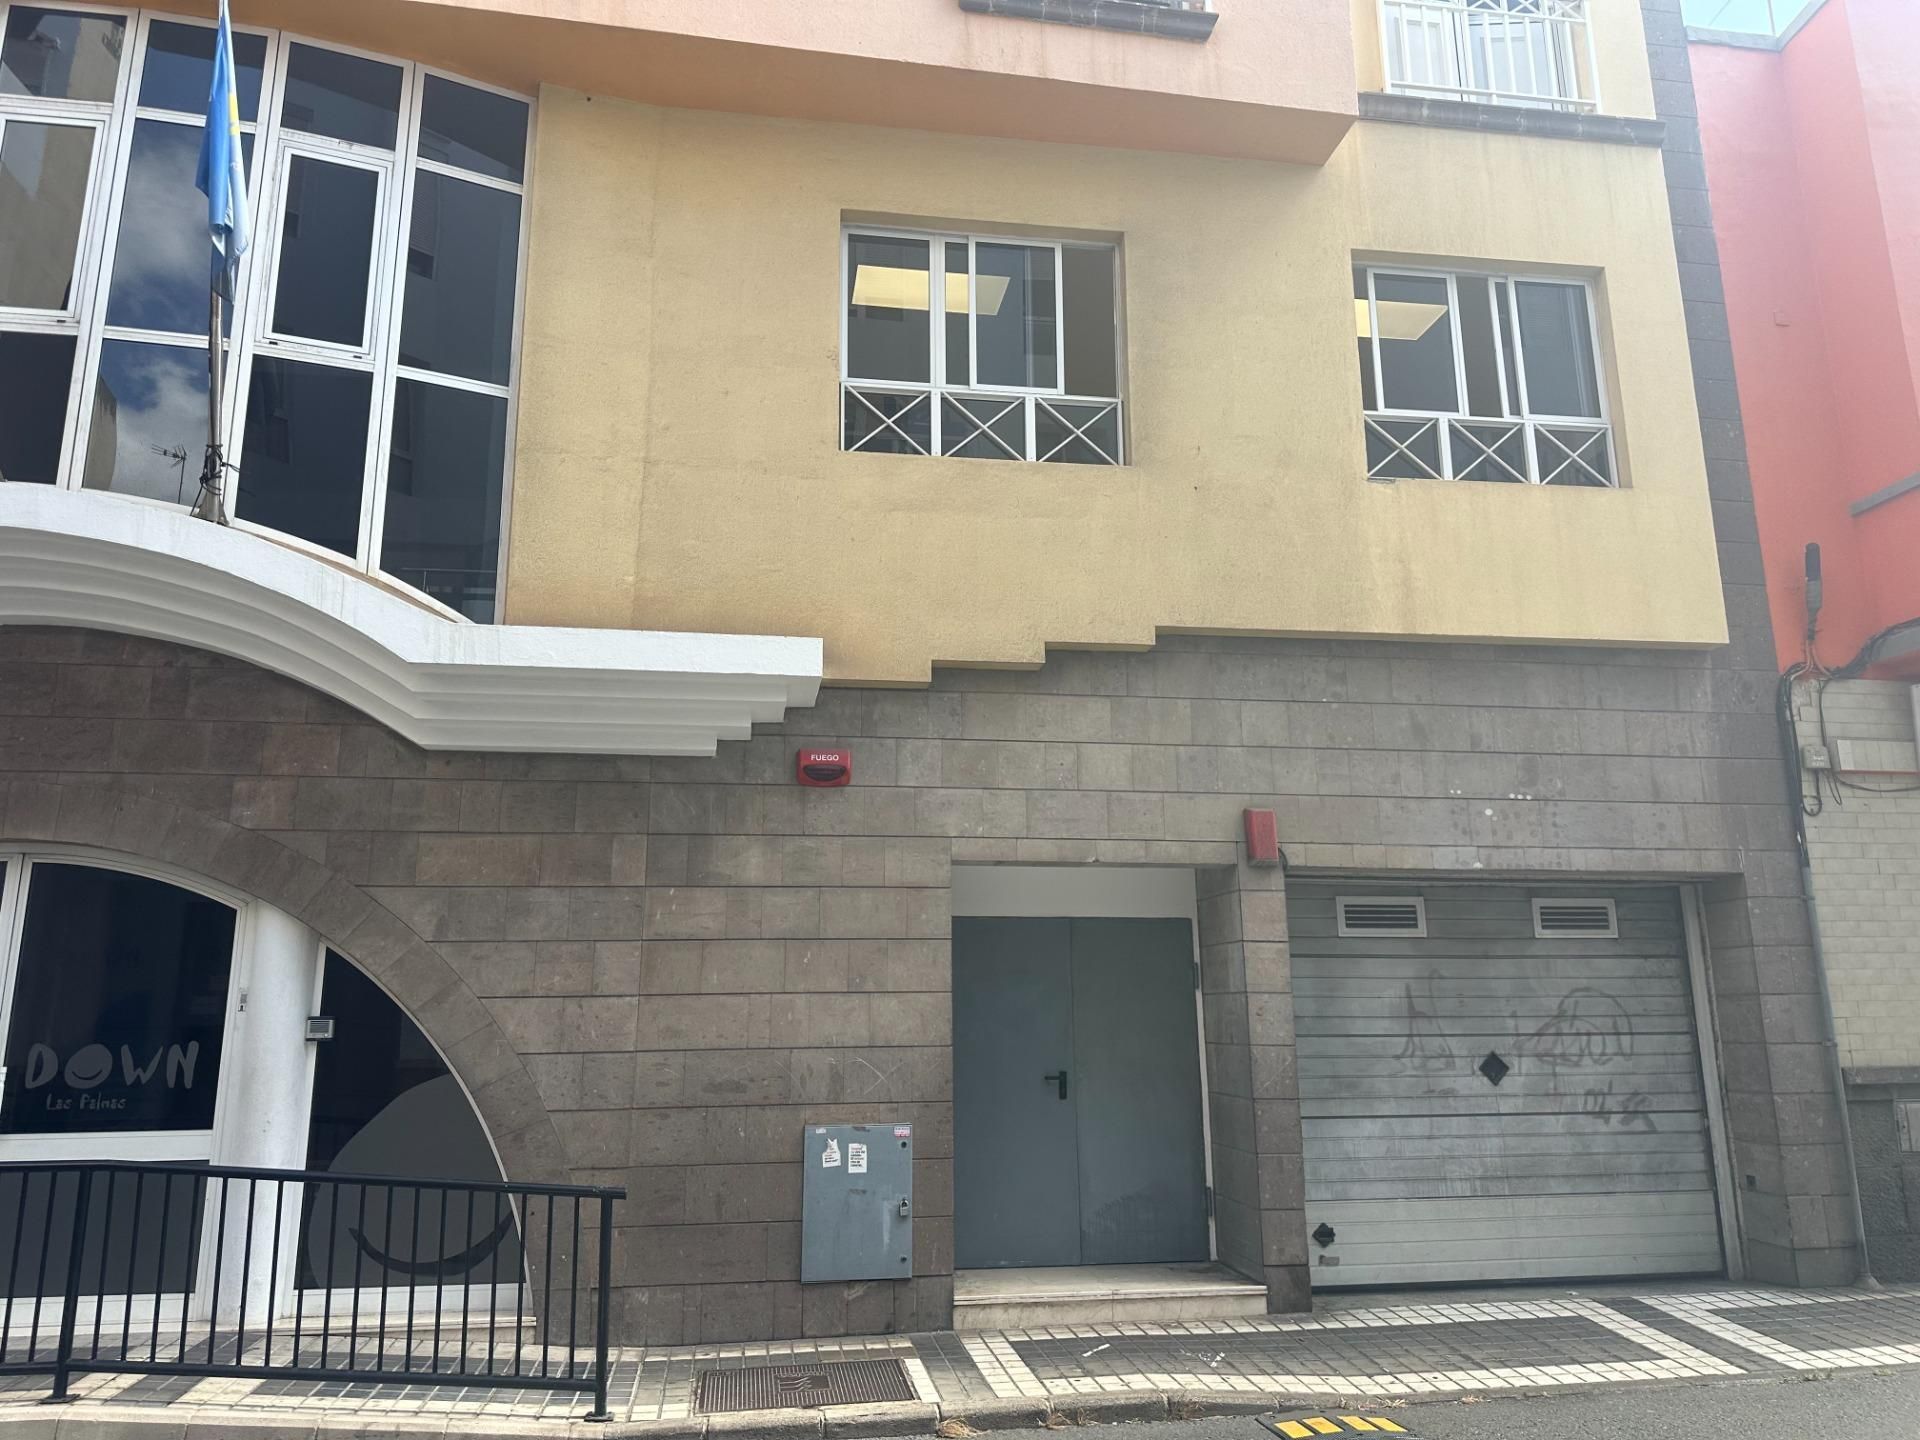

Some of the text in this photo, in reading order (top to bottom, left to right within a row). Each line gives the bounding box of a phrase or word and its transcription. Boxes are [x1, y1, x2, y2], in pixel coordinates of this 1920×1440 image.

[25, 1041, 199, 1089] DOWN
[46, 1093, 127, 1110] Las Palmas
